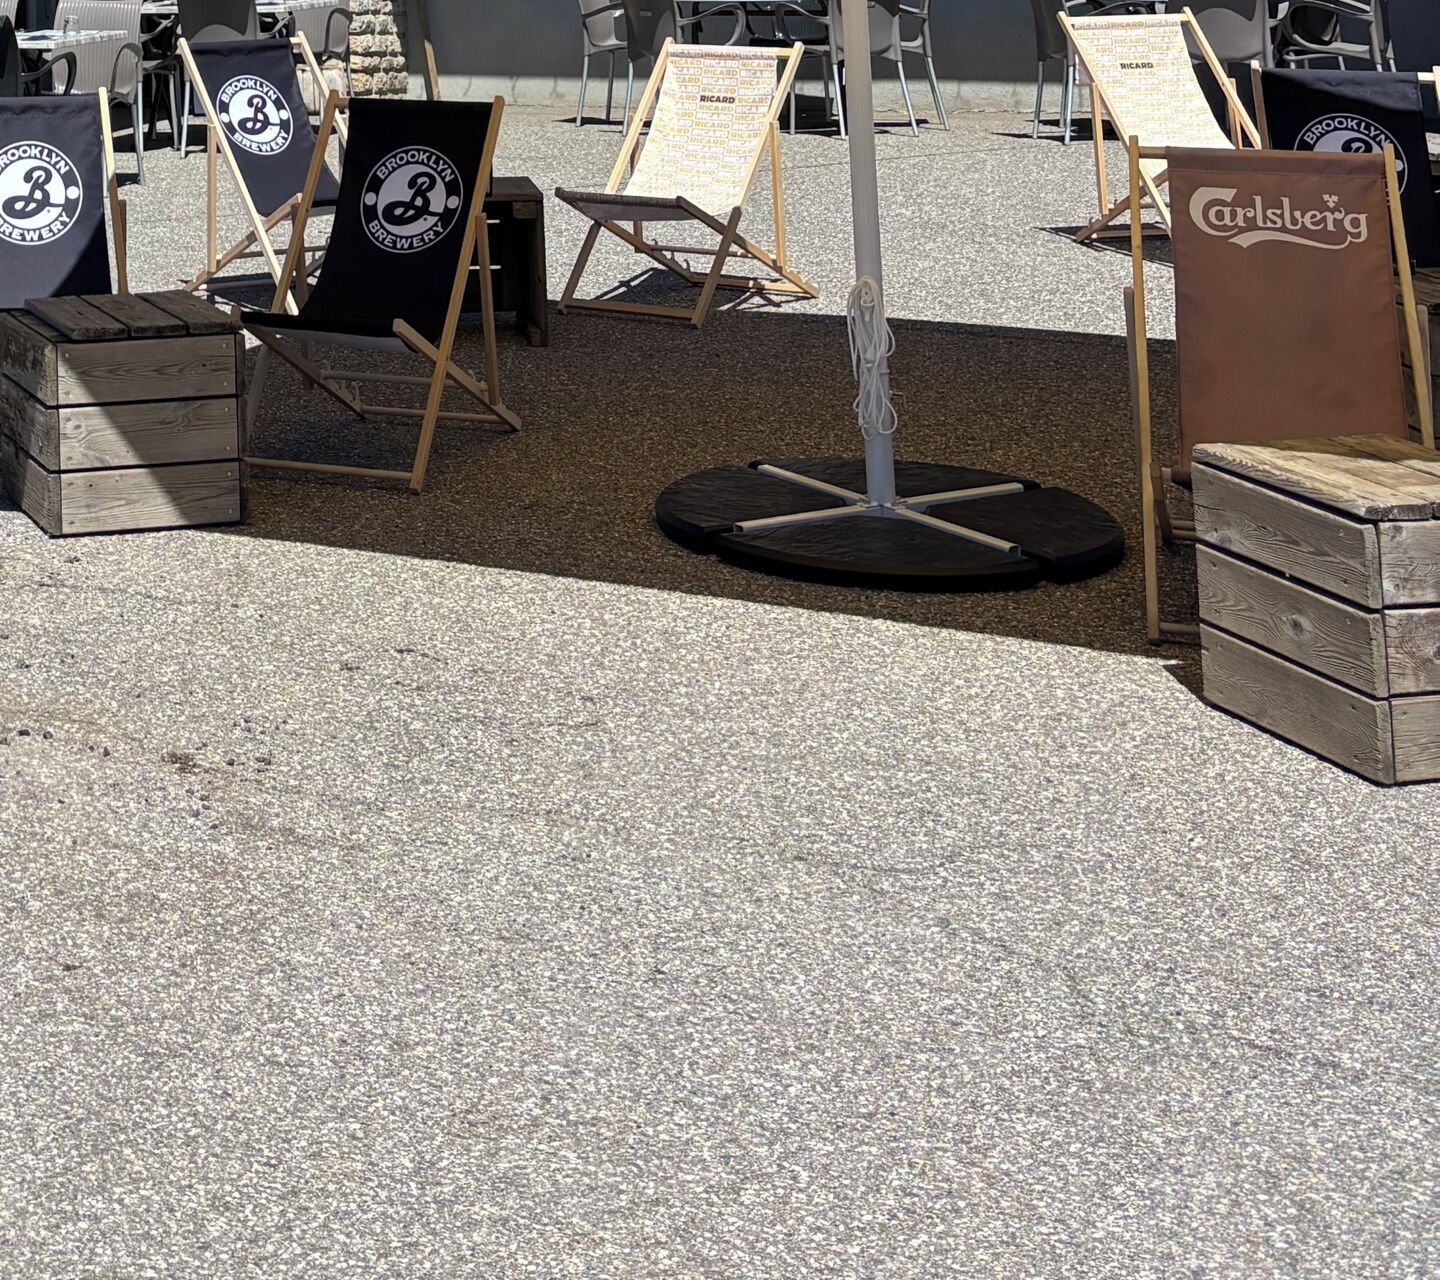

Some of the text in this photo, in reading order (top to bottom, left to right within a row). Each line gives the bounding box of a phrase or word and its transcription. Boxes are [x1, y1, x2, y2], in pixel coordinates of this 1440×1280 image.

[1120, 62, 1154, 70] RICARD
[221, 79, 277, 103] BROOKLYN
[700, 95, 736, 104] RICARD
[233, 129, 288, 152] BREWERY
[1303, 117, 1391, 146] BROOKLYN
[376, 151, 455, 182] BROOKLYN
[1189, 187, 1368, 245] Carlsberg
[369, 220, 444, 249] BREWERY
